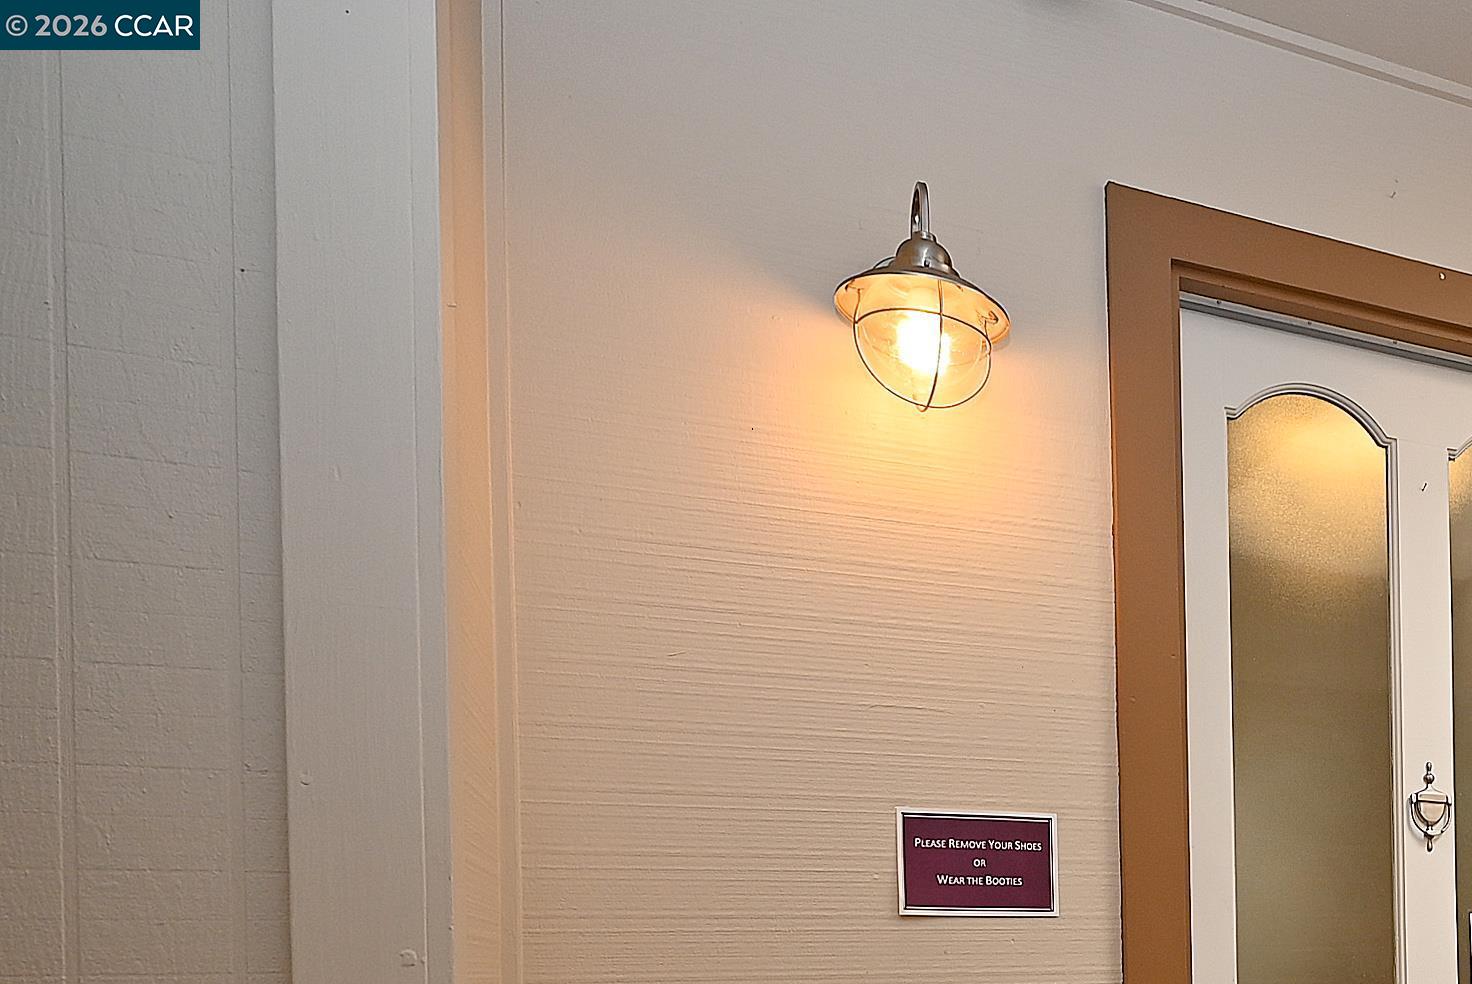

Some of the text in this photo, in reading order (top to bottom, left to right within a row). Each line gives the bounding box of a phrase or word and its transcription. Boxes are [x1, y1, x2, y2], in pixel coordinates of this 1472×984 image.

[914, 837, 1042, 851] PLEASE REMOVE YOUR SHOES
[973, 858, 987, 868] OR
[937, 874, 1023, 886] WEAR THE BOOTIES
